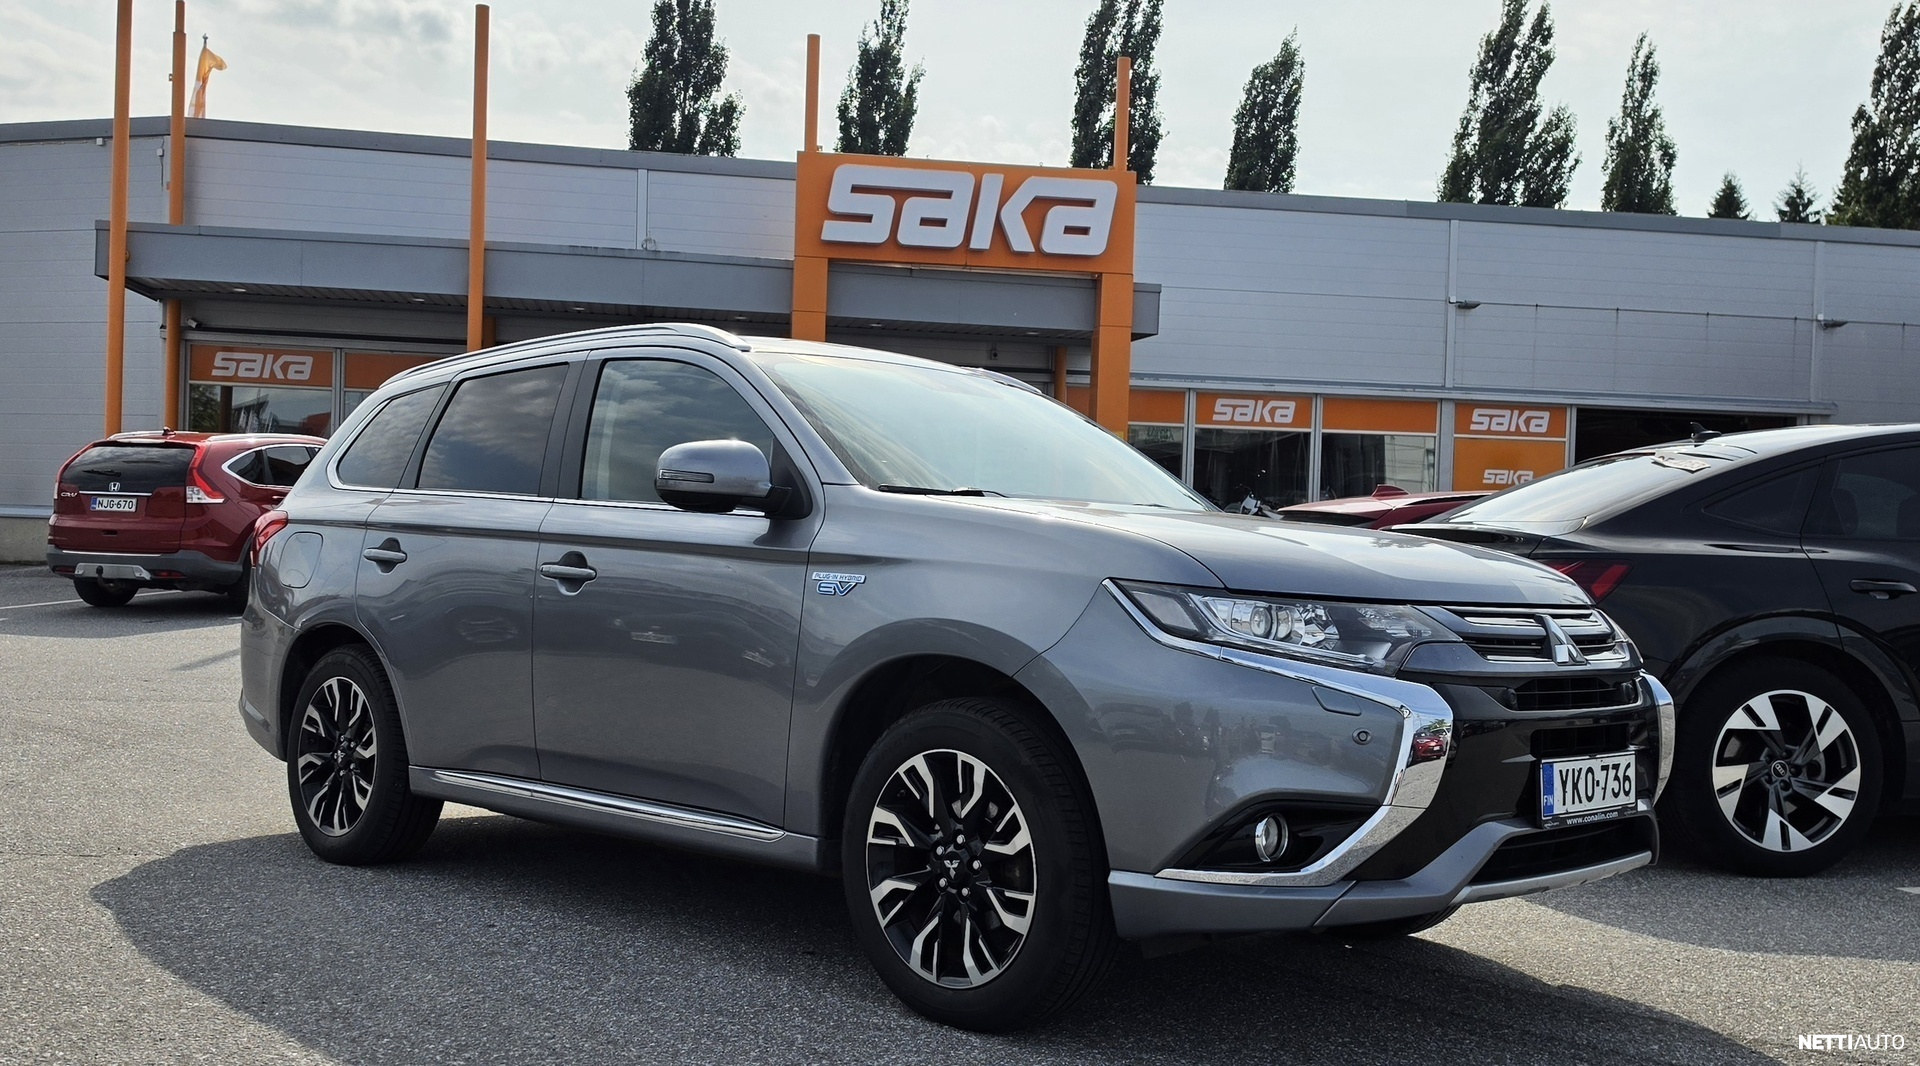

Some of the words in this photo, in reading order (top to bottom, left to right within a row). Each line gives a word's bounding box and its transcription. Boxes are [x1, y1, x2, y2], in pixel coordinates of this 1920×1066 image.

[97, 500, 134, 510] NJG-670
[839, 574, 863, 582] HYBRID
[817, 581, 857, 596] EV
[1559, 762, 1632, 806] YKO-736
[1543, 794, 1554, 806] FIN
[1566, 811, 1619, 825] www.conalin.com
